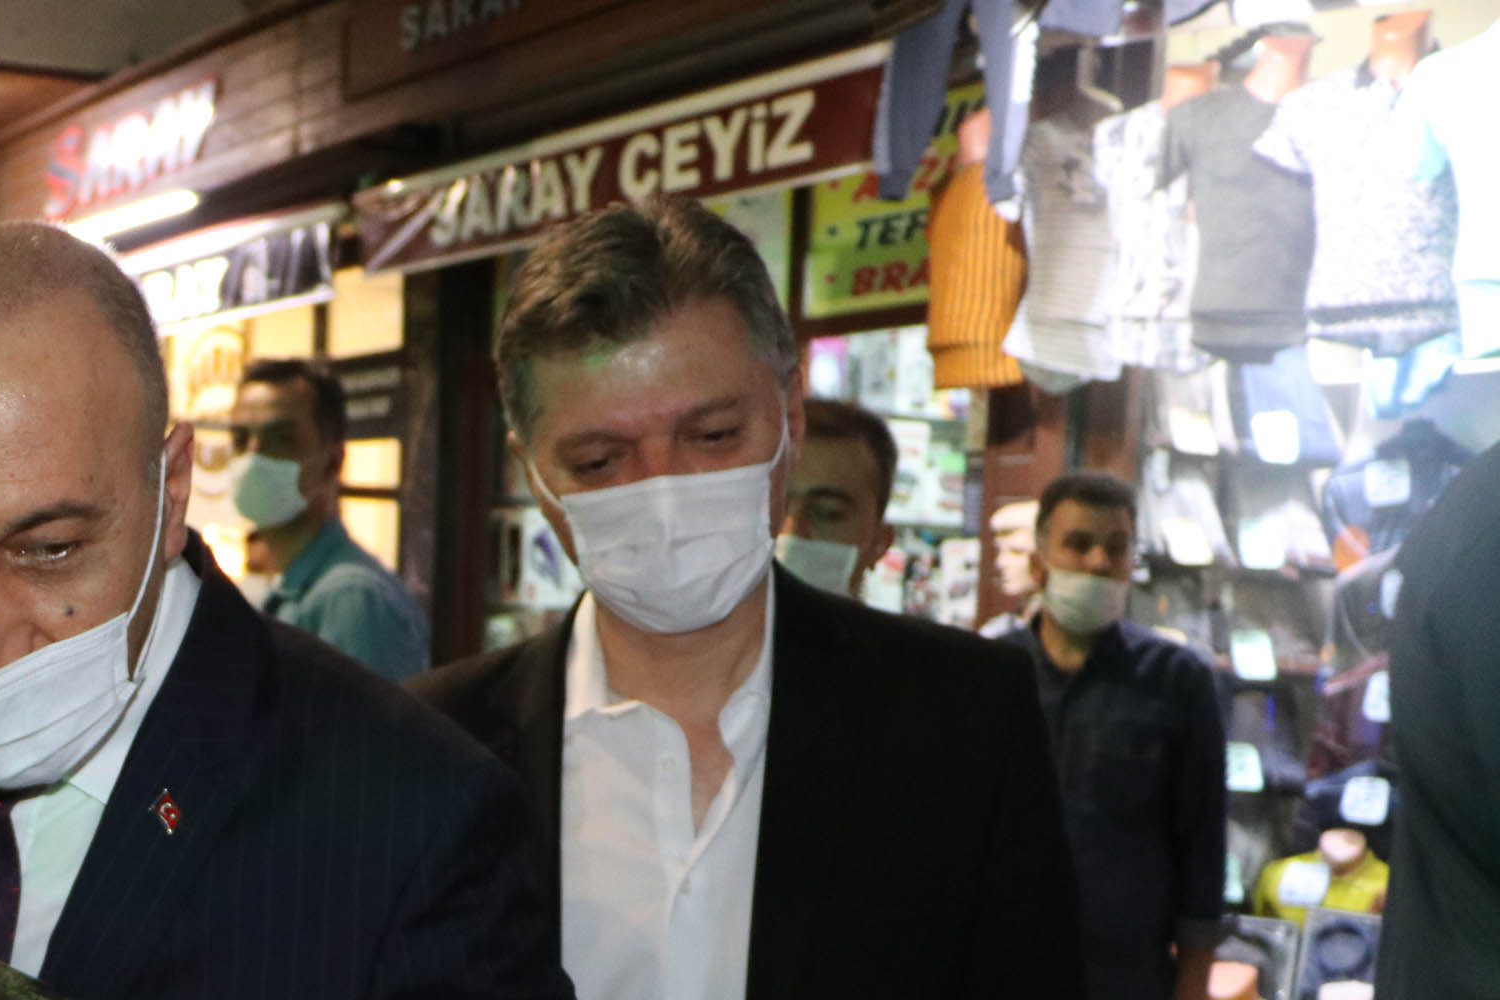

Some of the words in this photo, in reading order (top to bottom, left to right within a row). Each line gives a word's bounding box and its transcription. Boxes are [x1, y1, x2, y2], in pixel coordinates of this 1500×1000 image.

[429, 148, 601, 250] SARAY
[857, 208, 930, 250] TEF
[852, 257, 930, 297] BRA
